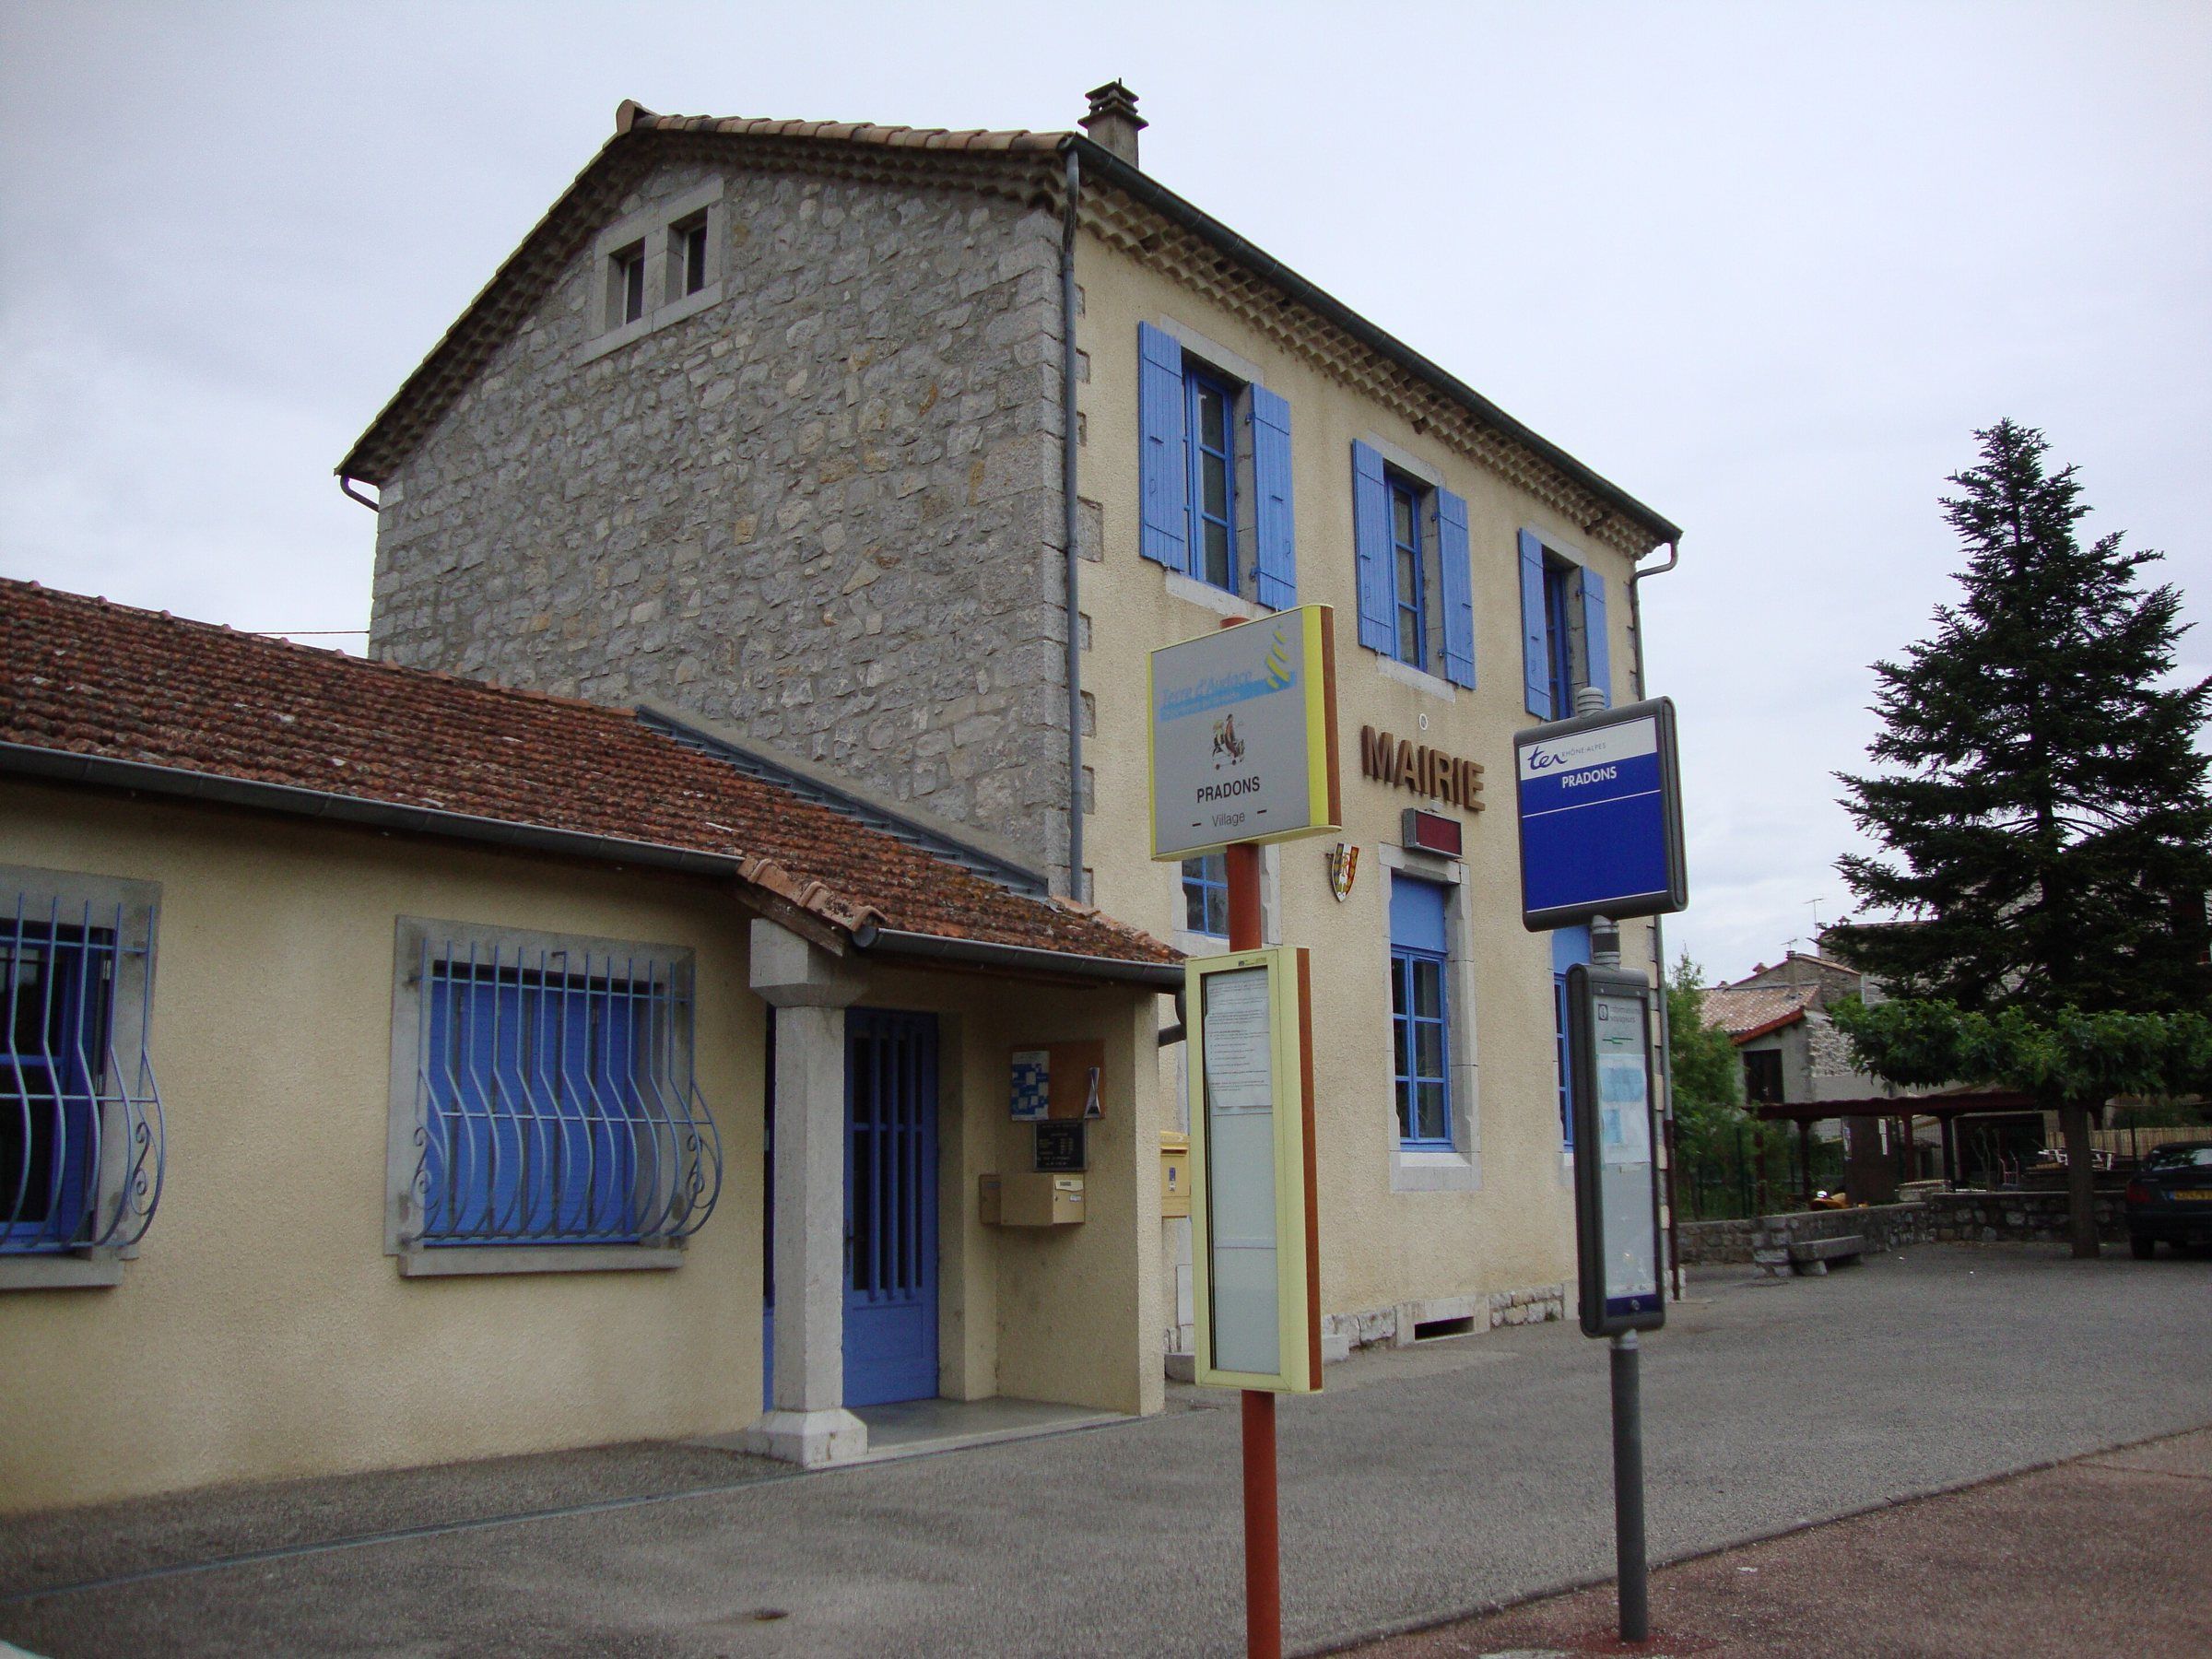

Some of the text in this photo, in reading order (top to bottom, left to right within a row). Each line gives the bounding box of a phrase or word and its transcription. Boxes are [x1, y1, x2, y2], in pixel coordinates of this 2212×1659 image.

[1361, 725, 1486, 812] MAIRIE
[1528, 746, 1567, 771] ter
[1197, 776, 1261, 803] PRADONS
[1561, 765, 1618, 789] PRADONS
[1212, 812, 1245, 828] Village
